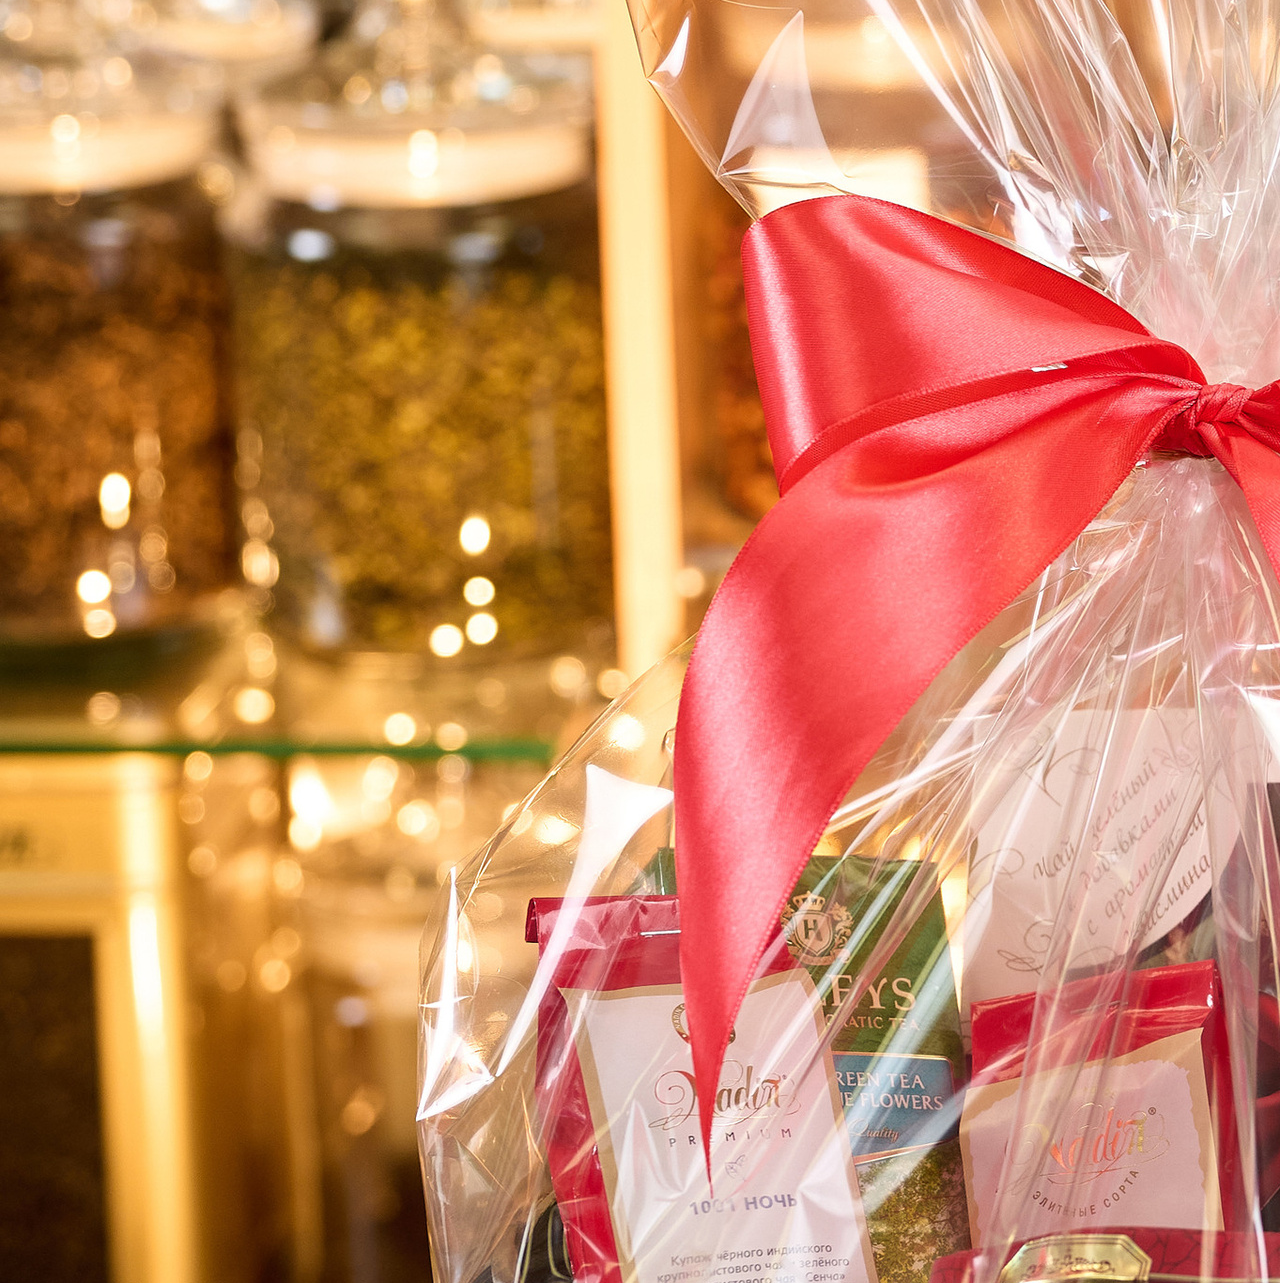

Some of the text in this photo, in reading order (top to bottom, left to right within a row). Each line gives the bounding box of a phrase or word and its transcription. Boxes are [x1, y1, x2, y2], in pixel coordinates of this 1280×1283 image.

[834, 1069, 926, 1090] REEN TEA
[859, 1092, 944, 1112] FLOWERS
[848, 1118, 900, 1143] Quality
[1103, 1168, 1139, 1209] СОРТА
[744, 1193, 798, 1211] НОЧЬ
[716, 1248, 764, 1262] чёрного
[766, 1243, 833, 1256] индийского
[799, 1256, 850, 1269] зелёного
